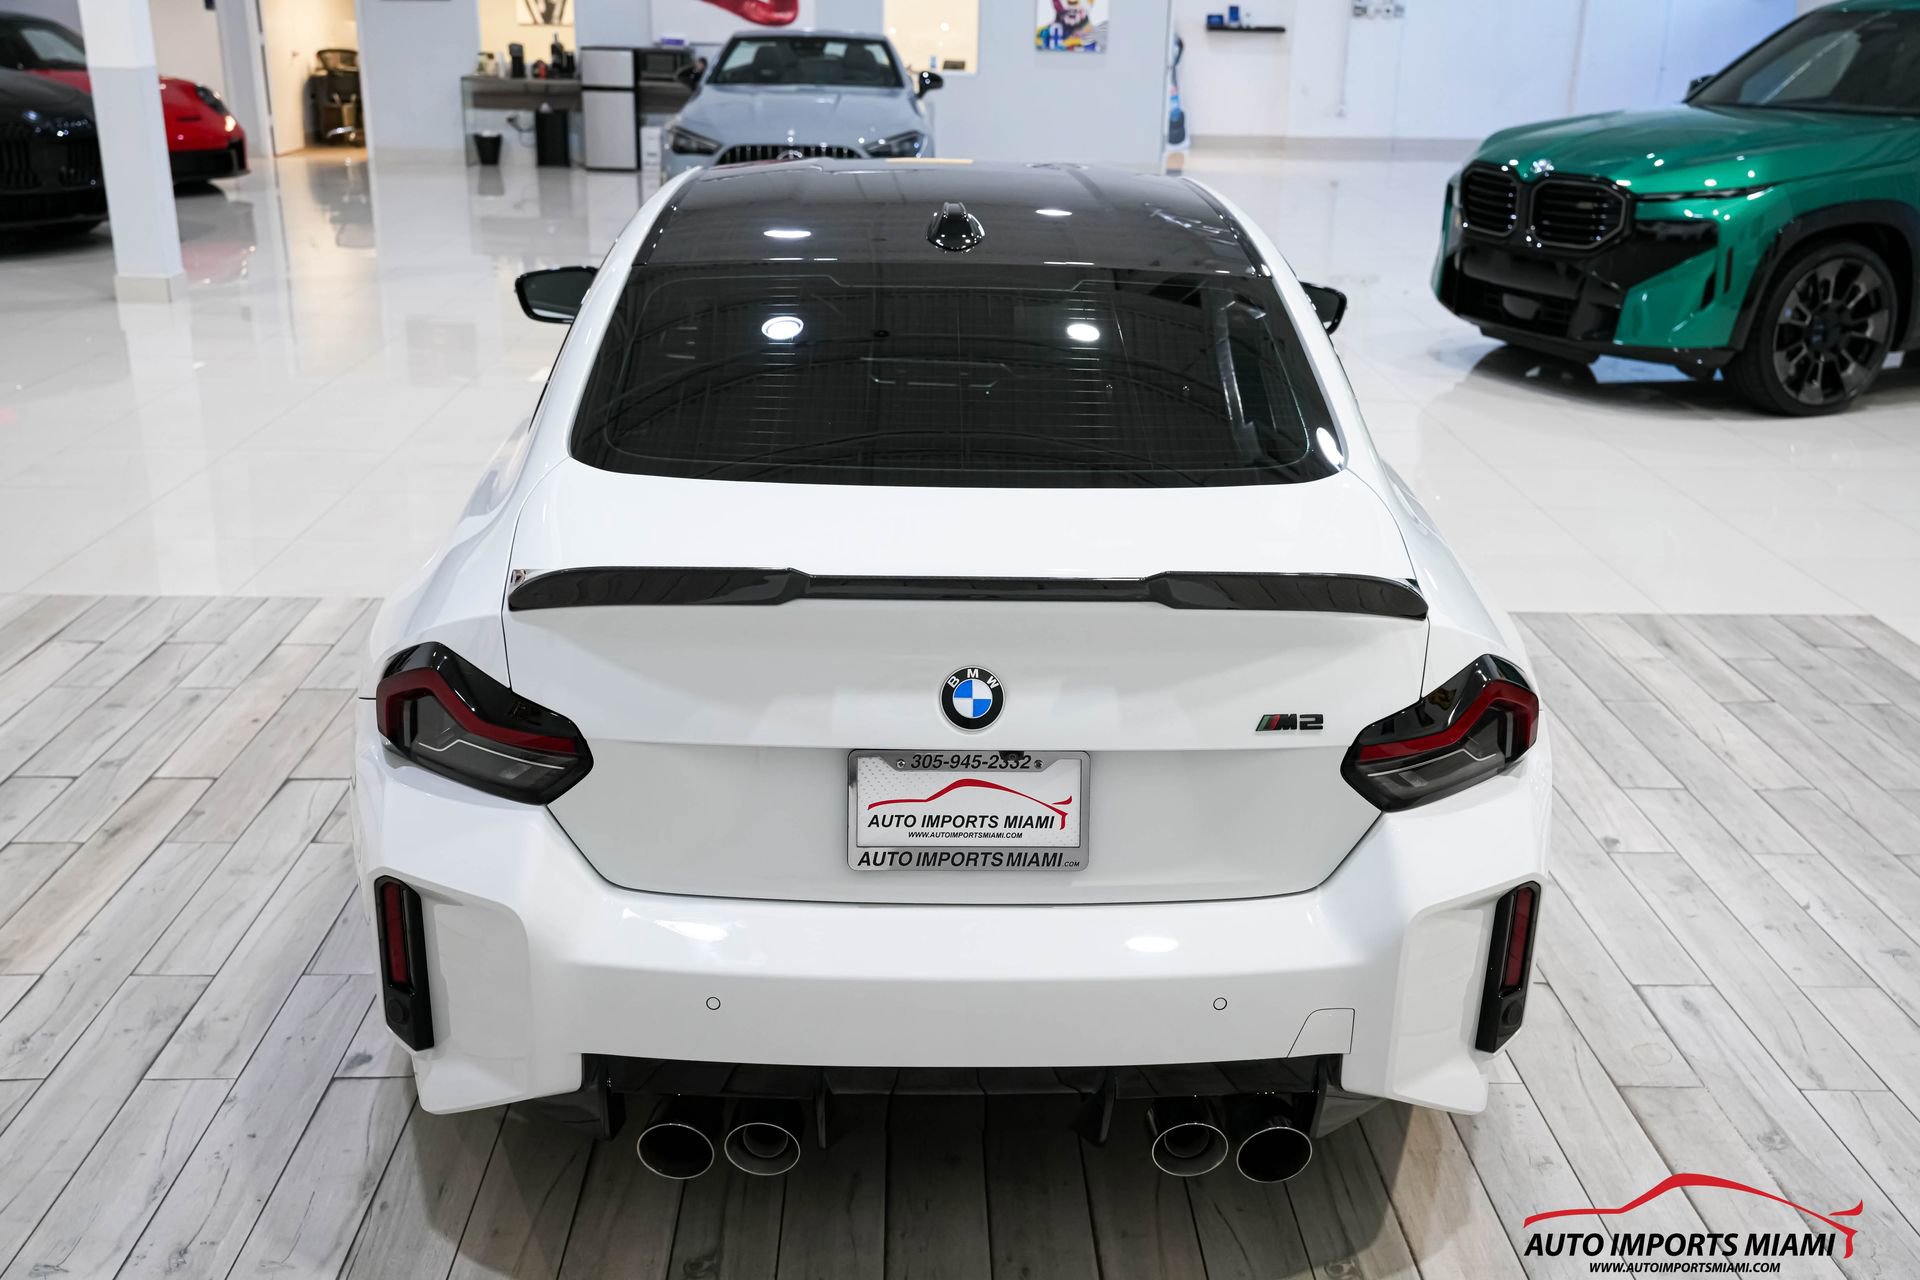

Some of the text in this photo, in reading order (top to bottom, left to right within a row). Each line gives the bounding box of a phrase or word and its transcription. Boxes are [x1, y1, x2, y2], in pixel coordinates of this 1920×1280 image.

[947, 668, 1000, 689] BMW
[1256, 713, 1324, 731] M2
[867, 814, 1055, 829] AUTO IMPORTS MIAMI
[908, 831, 1023, 839] WWW.AUTOIMPORTSMIAMI.COM
[857, 851, 913, 867] AUTO
[916, 851, 1004, 867] IMPORTS
